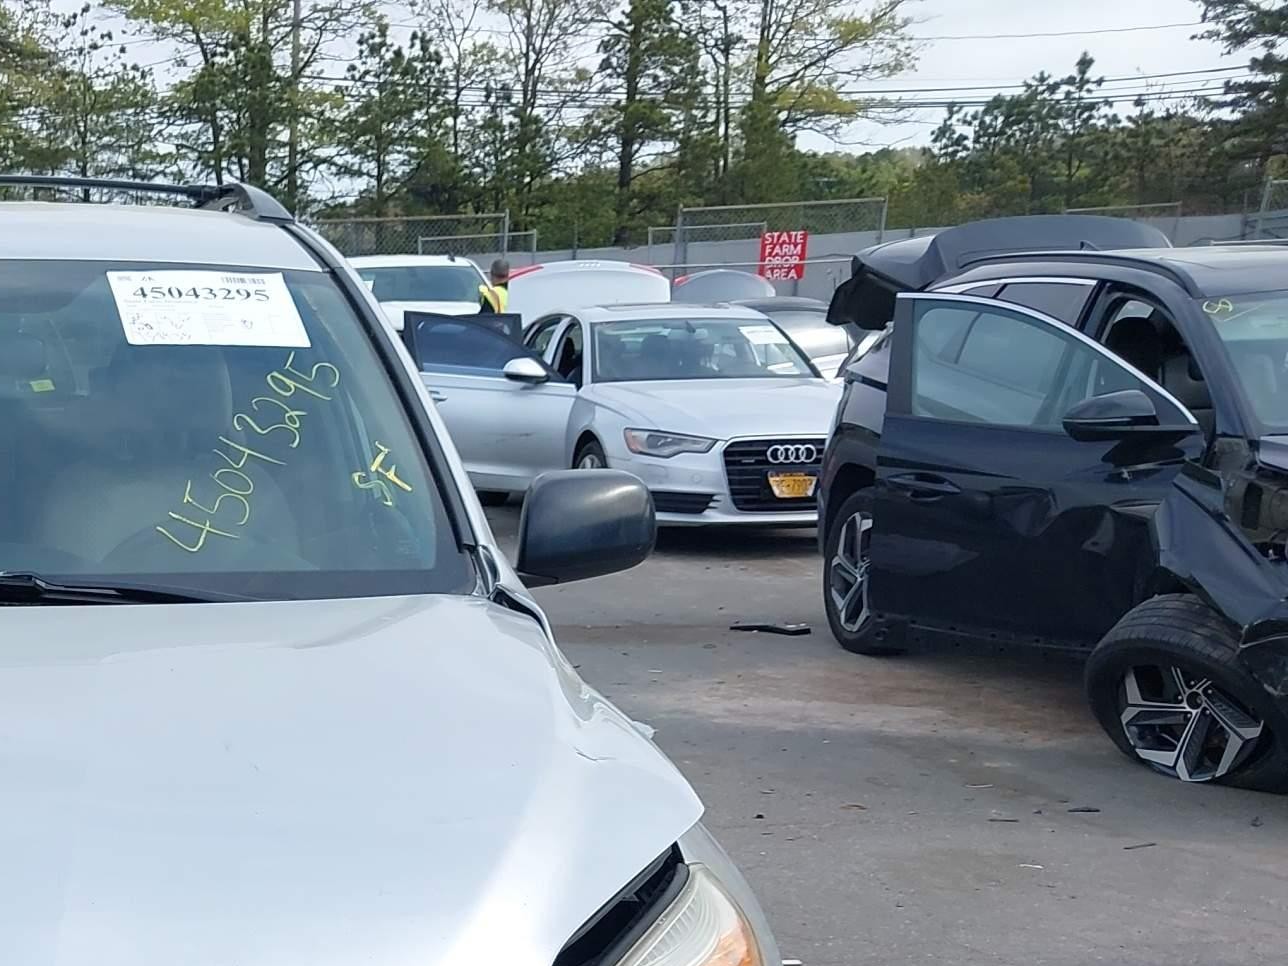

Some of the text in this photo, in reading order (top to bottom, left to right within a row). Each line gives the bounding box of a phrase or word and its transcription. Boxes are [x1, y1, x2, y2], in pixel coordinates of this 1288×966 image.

[764, 230, 805, 244] STATE
[764, 243, 802, 257] FARM
[764, 256, 800, 269] DROP
[764, 268, 798, 281] AREA
[132, 285, 271, 303] 45043295
[156, 351, 340, 552] 45043295
